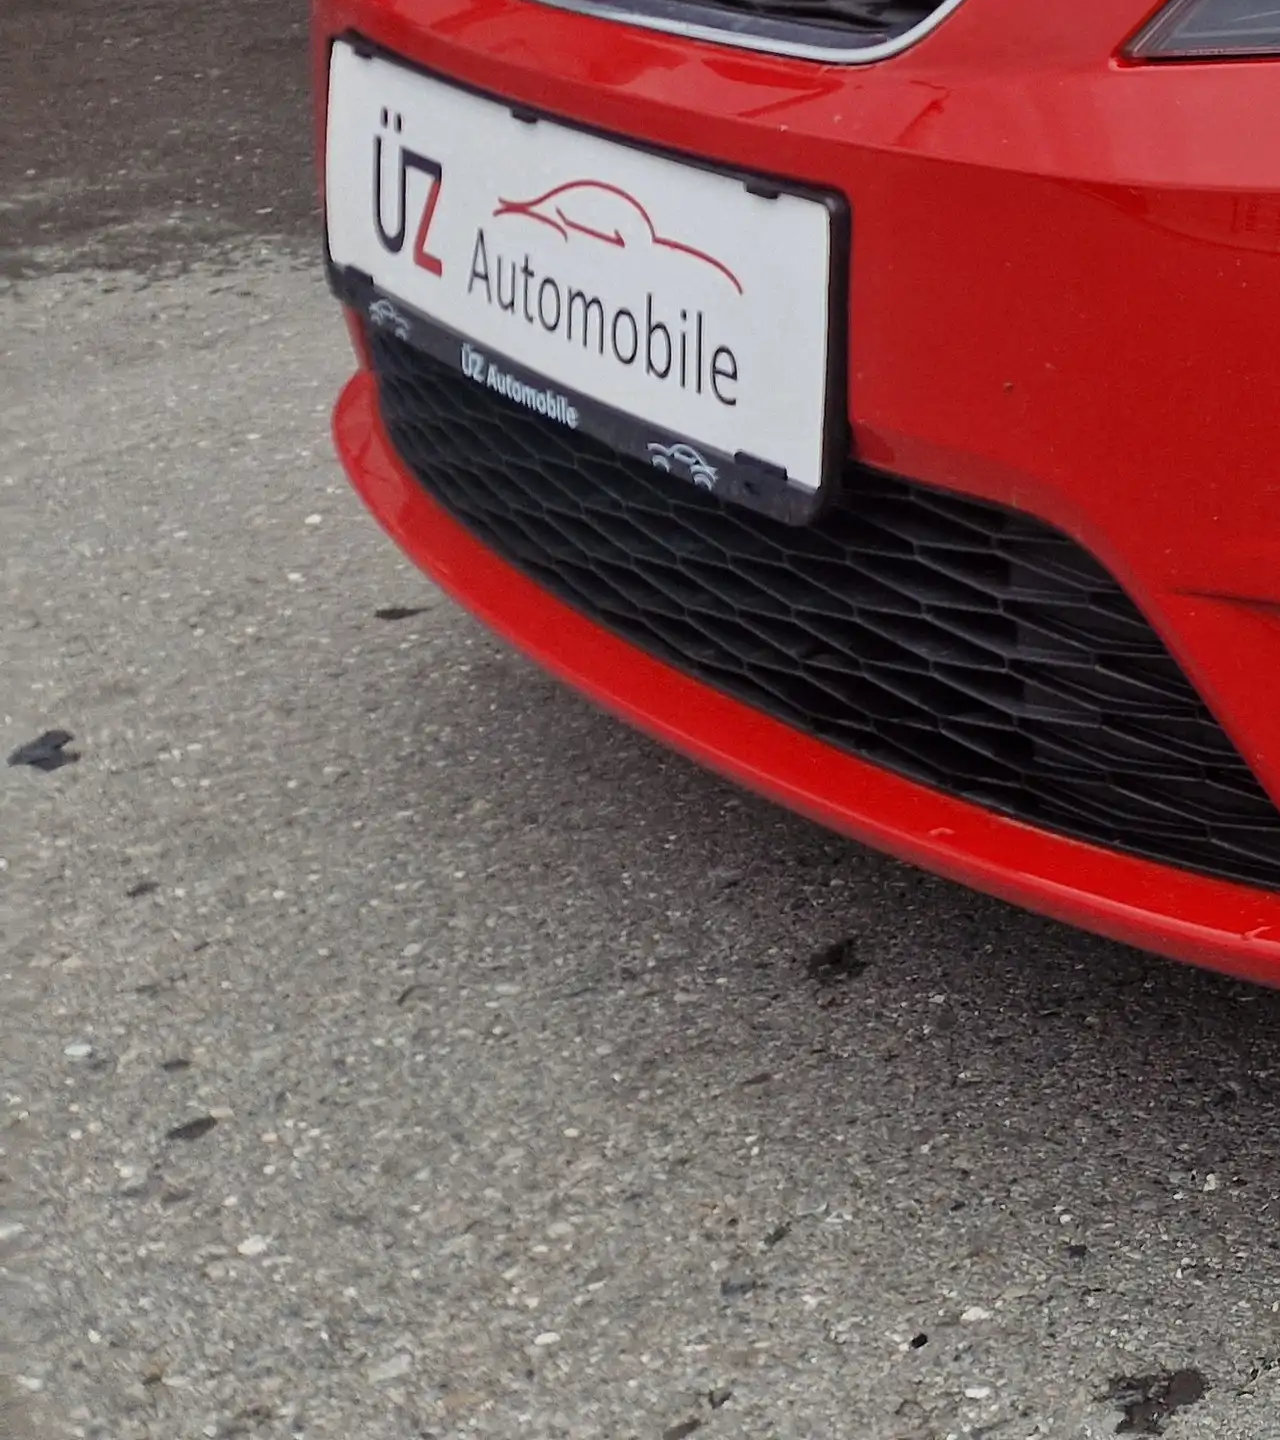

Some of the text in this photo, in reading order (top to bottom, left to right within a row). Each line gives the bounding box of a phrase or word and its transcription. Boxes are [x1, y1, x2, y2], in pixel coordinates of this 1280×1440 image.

[373, 107, 740, 407] ÜZ Automobile
[461, 342, 579, 429] ÜZ Automobile
